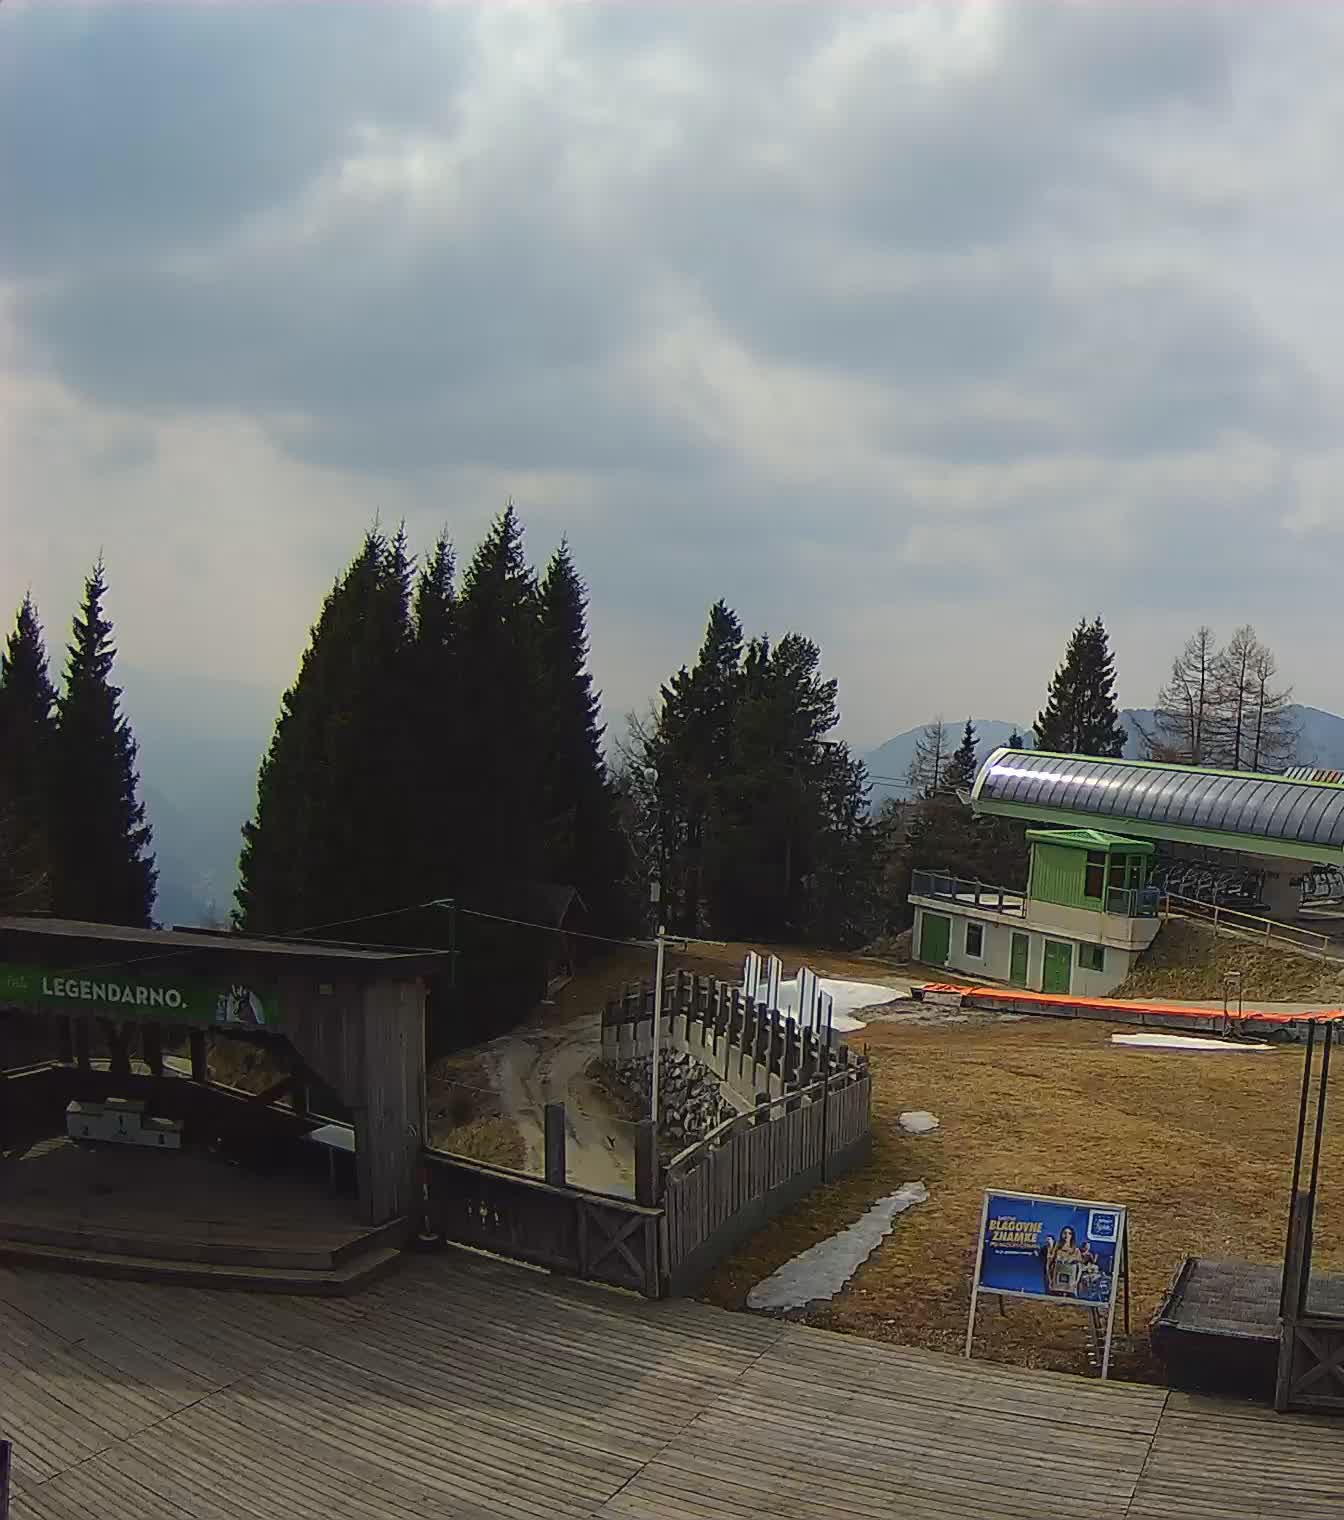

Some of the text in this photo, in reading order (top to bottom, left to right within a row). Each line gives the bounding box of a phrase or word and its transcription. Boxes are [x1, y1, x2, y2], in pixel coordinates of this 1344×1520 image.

[42, 976, 189, 1009] LEGENDARNO.
[988, 1219, 1043, 1233] BLAGOVNE
[991, 1231, 1038, 1243] ZNAMKE
